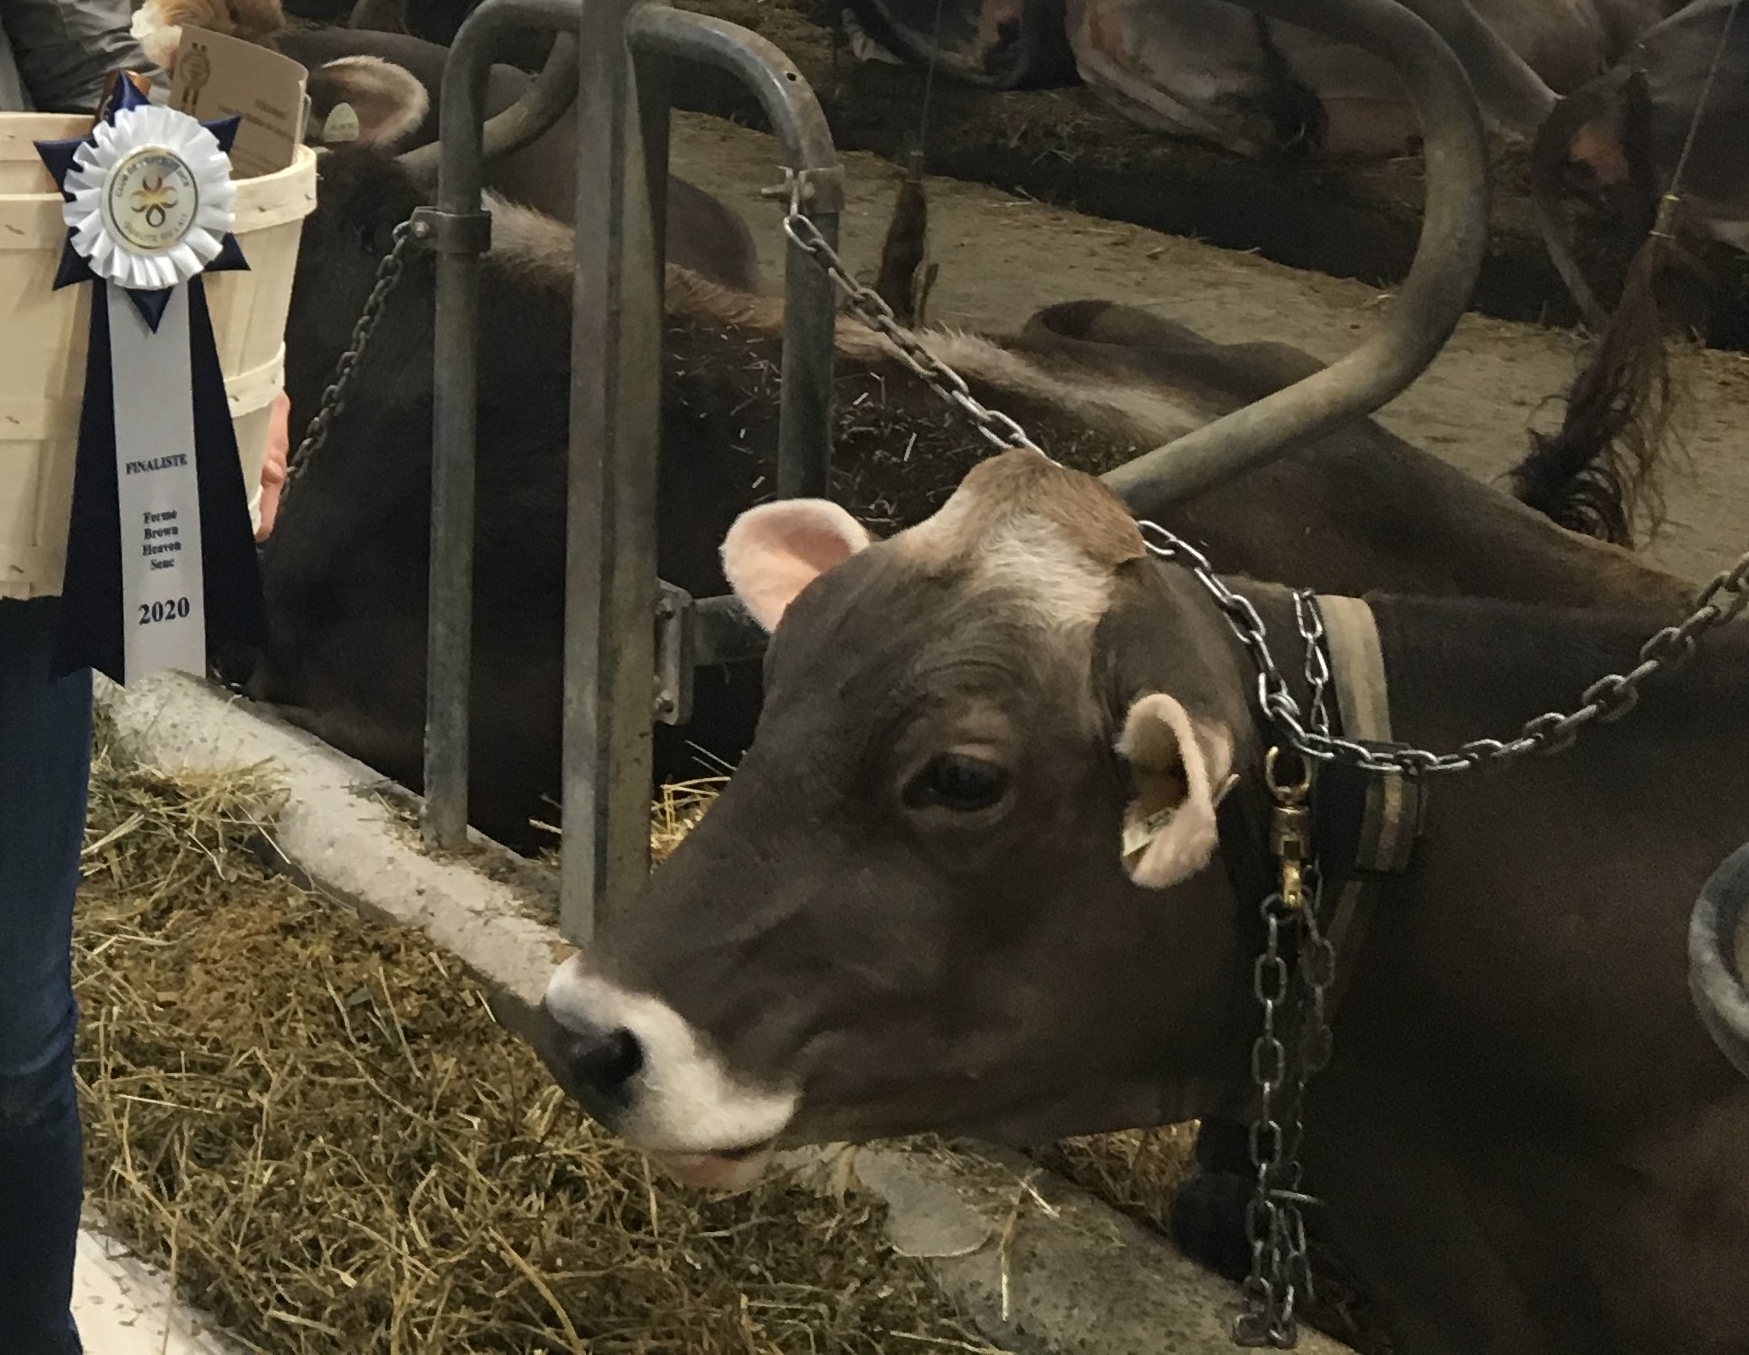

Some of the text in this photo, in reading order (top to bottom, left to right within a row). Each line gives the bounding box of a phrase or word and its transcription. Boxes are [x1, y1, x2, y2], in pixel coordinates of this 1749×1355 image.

[125, 453, 188, 475] FINALISTE
[143, 525, 179, 541] Brown
[142, 540, 182, 557] Heaven
[138, 596, 190, 626] 2020
